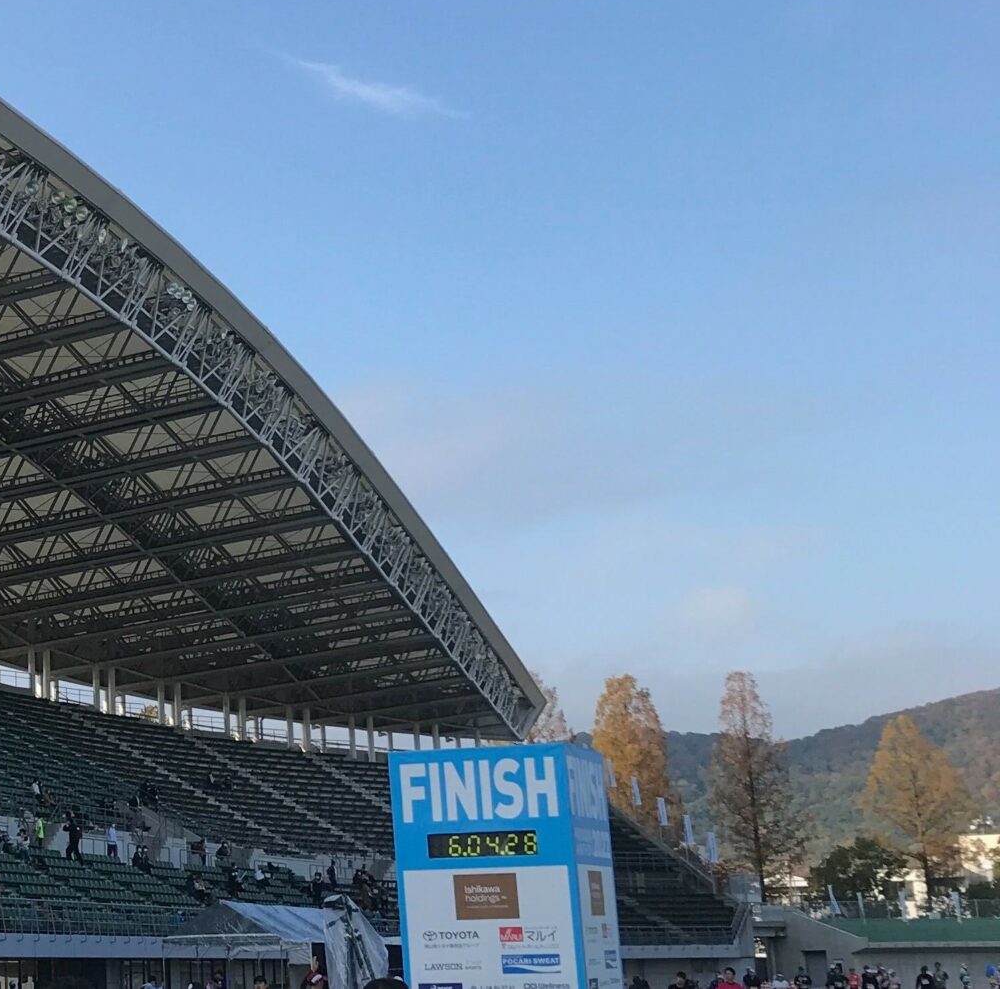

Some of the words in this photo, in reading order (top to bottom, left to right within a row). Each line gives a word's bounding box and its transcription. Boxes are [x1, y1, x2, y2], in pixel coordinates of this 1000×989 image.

[400, 756, 559, 824] FINISH
[438, 930, 480, 940] TOYOTA
[526, 930, 557, 942] マルイ
[533, 957, 560, 965] SWEAT
[424, 963, 463, 971] LAWSON
